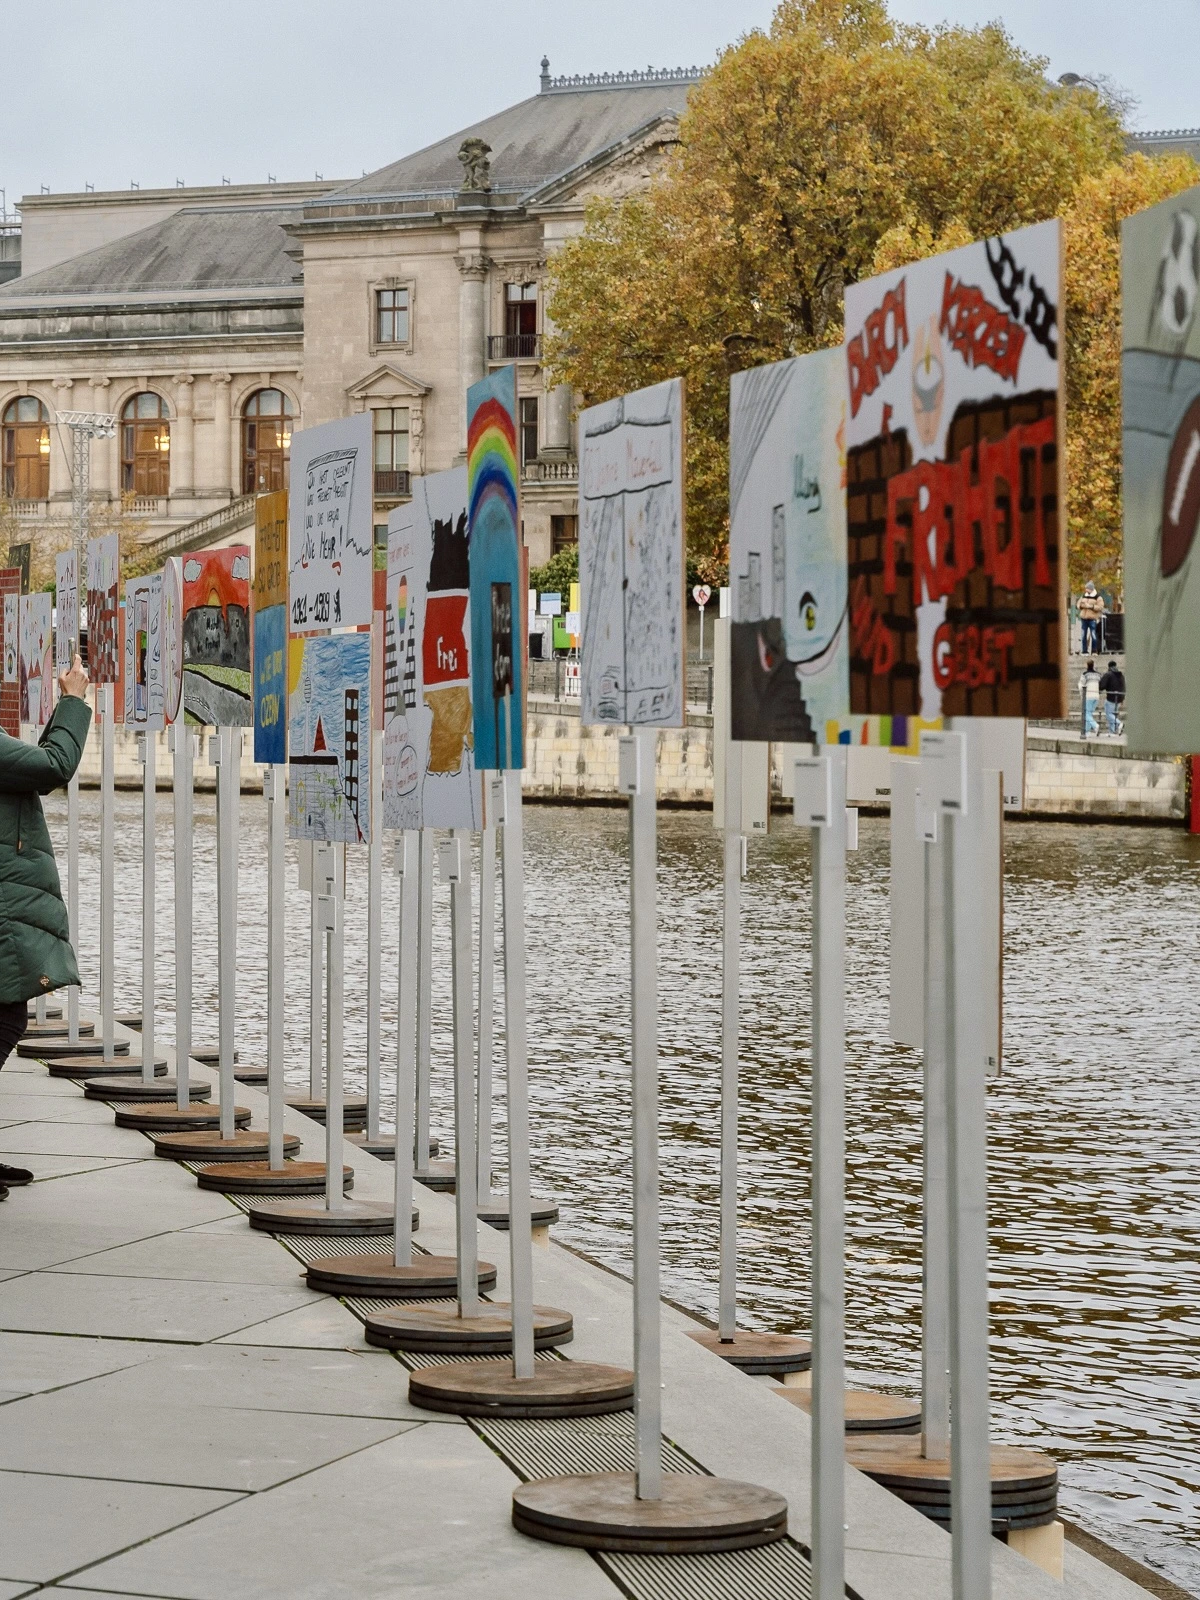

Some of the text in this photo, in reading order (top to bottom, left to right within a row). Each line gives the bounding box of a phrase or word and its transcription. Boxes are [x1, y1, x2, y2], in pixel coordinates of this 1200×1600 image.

[847, 268, 1026, 420] DURCH KERZEN
[883, 412, 1057, 607] FREIHEIT
[932, 623, 1014, 690] GEBET
